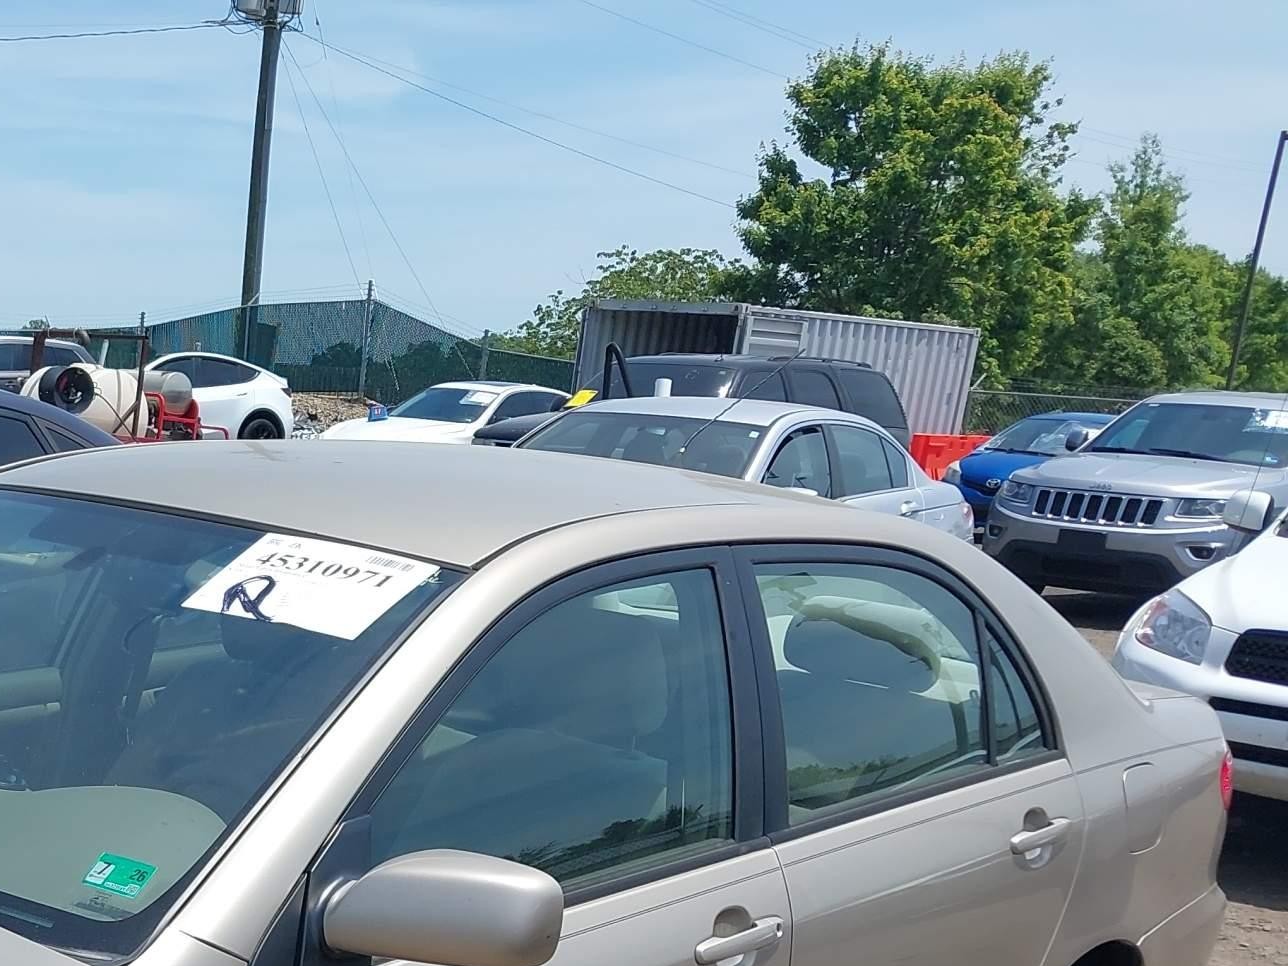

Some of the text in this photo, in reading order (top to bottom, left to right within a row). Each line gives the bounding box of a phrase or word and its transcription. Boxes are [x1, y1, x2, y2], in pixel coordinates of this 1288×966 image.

[256, 552, 395, 588] 45310971
[96, 861, 113, 875] 7
[129, 869, 149, 883] 26
